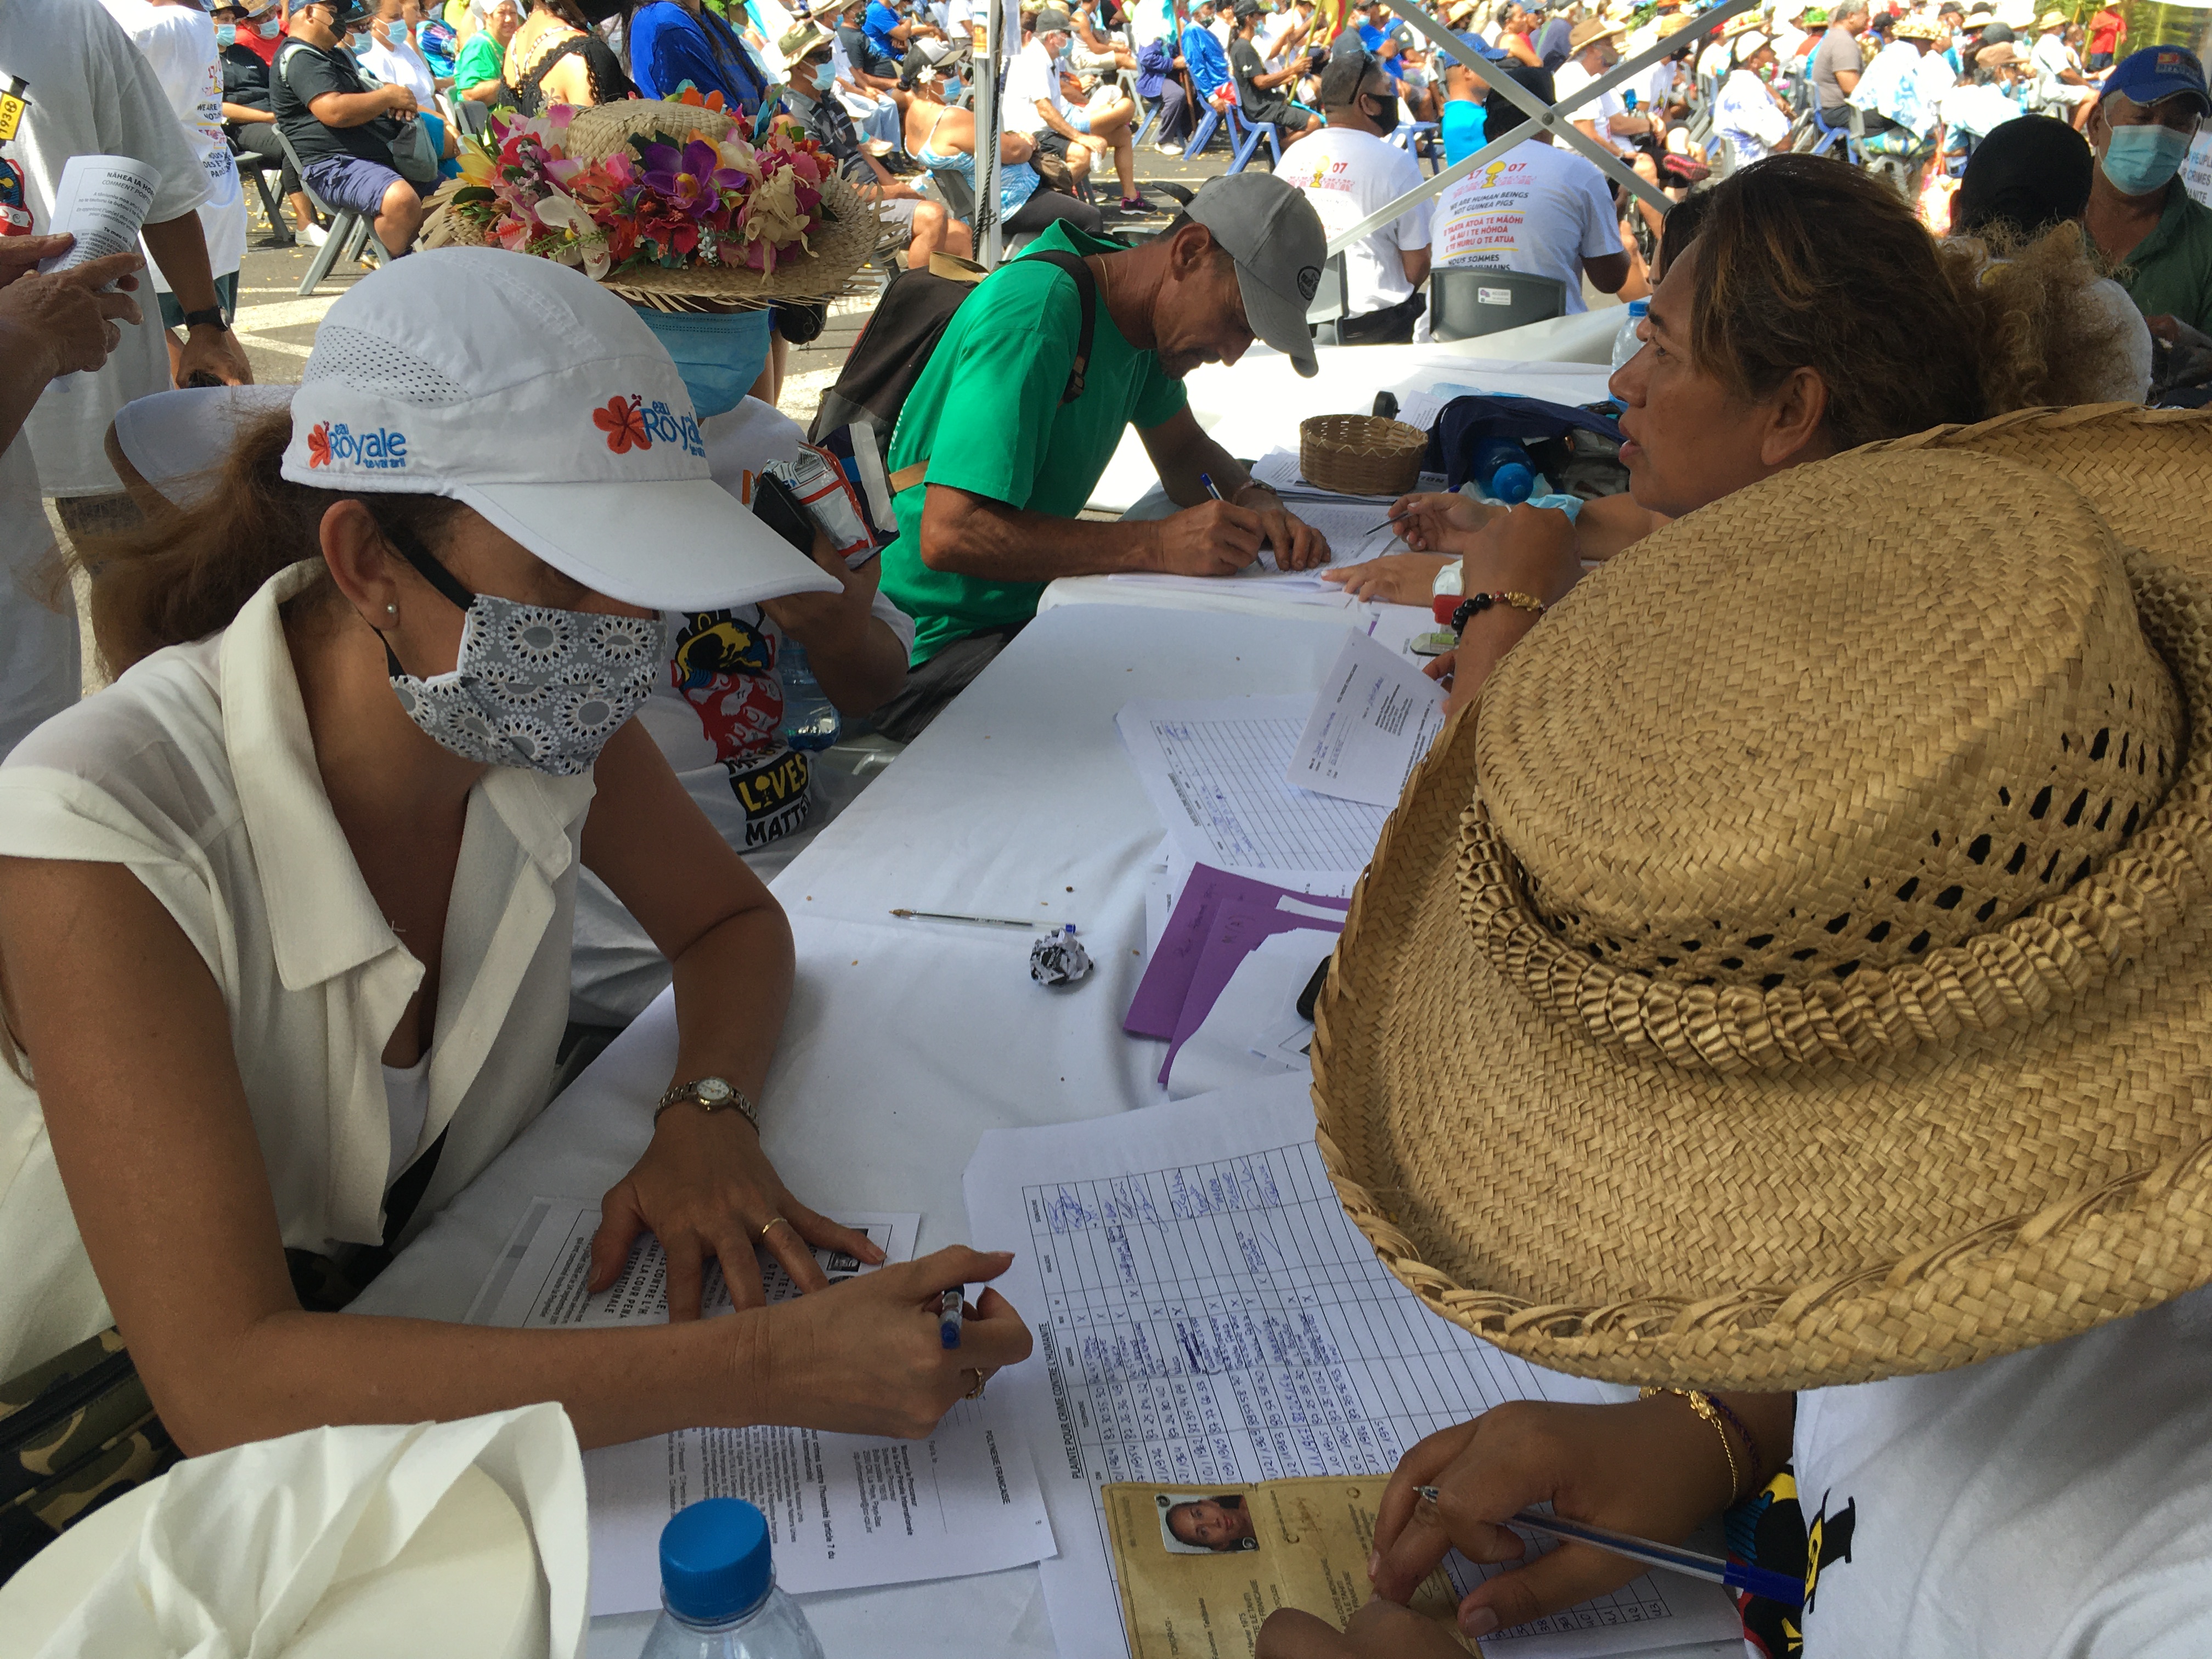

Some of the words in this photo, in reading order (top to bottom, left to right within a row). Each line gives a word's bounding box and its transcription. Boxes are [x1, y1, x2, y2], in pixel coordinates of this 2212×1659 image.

[1333, 162, 1348, 173] 07
[1468, 169, 1483, 180] 17
[1508, 163, 1527, 172] 07
[101, 179, 135, 191] COMMENT
[134, 179, 142, 187] IA
[1450, 202, 1458, 211] WE
[1458, 198, 1471, 207] ARE
[1472, 193, 1499, 202] HUMAN
[1454, 207, 1466, 216] NOT
[1466, 202, 1494, 212] GUINEA
[1448, 223, 1464, 234] TAATA
[1457, 231, 1465, 239] AU
[1448, 257, 1466, 266] NOUS
[1468, 254, 1500, 263] SOMMES
[652, 400, 670, 415] eau
[335, 424, 349, 435] eau
[328, 427, 407, 465] Royale
[639, 1263, 651, 1275] LA
[603, 1245, 642, 1315] INTERNATIONALE
[628, 1274, 646, 1298] COUR
[644, 1267, 665, 1300] CONTRE
[618, 1297, 636, 1321] PENA
[1037, 1321, 1056, 1366] L'HUMANITE
[1047, 1365, 1063, 1397] CONTRE
[1053, 1396, 1069, 1423] CRIME
[1059, 1422, 1074, 1446] POUR
[984, 1429, 1001, 1465] POLYNESIE
[1065, 1444, 1082, 1480] PLAINTE
[816, 1464, 825, 1484] contre
